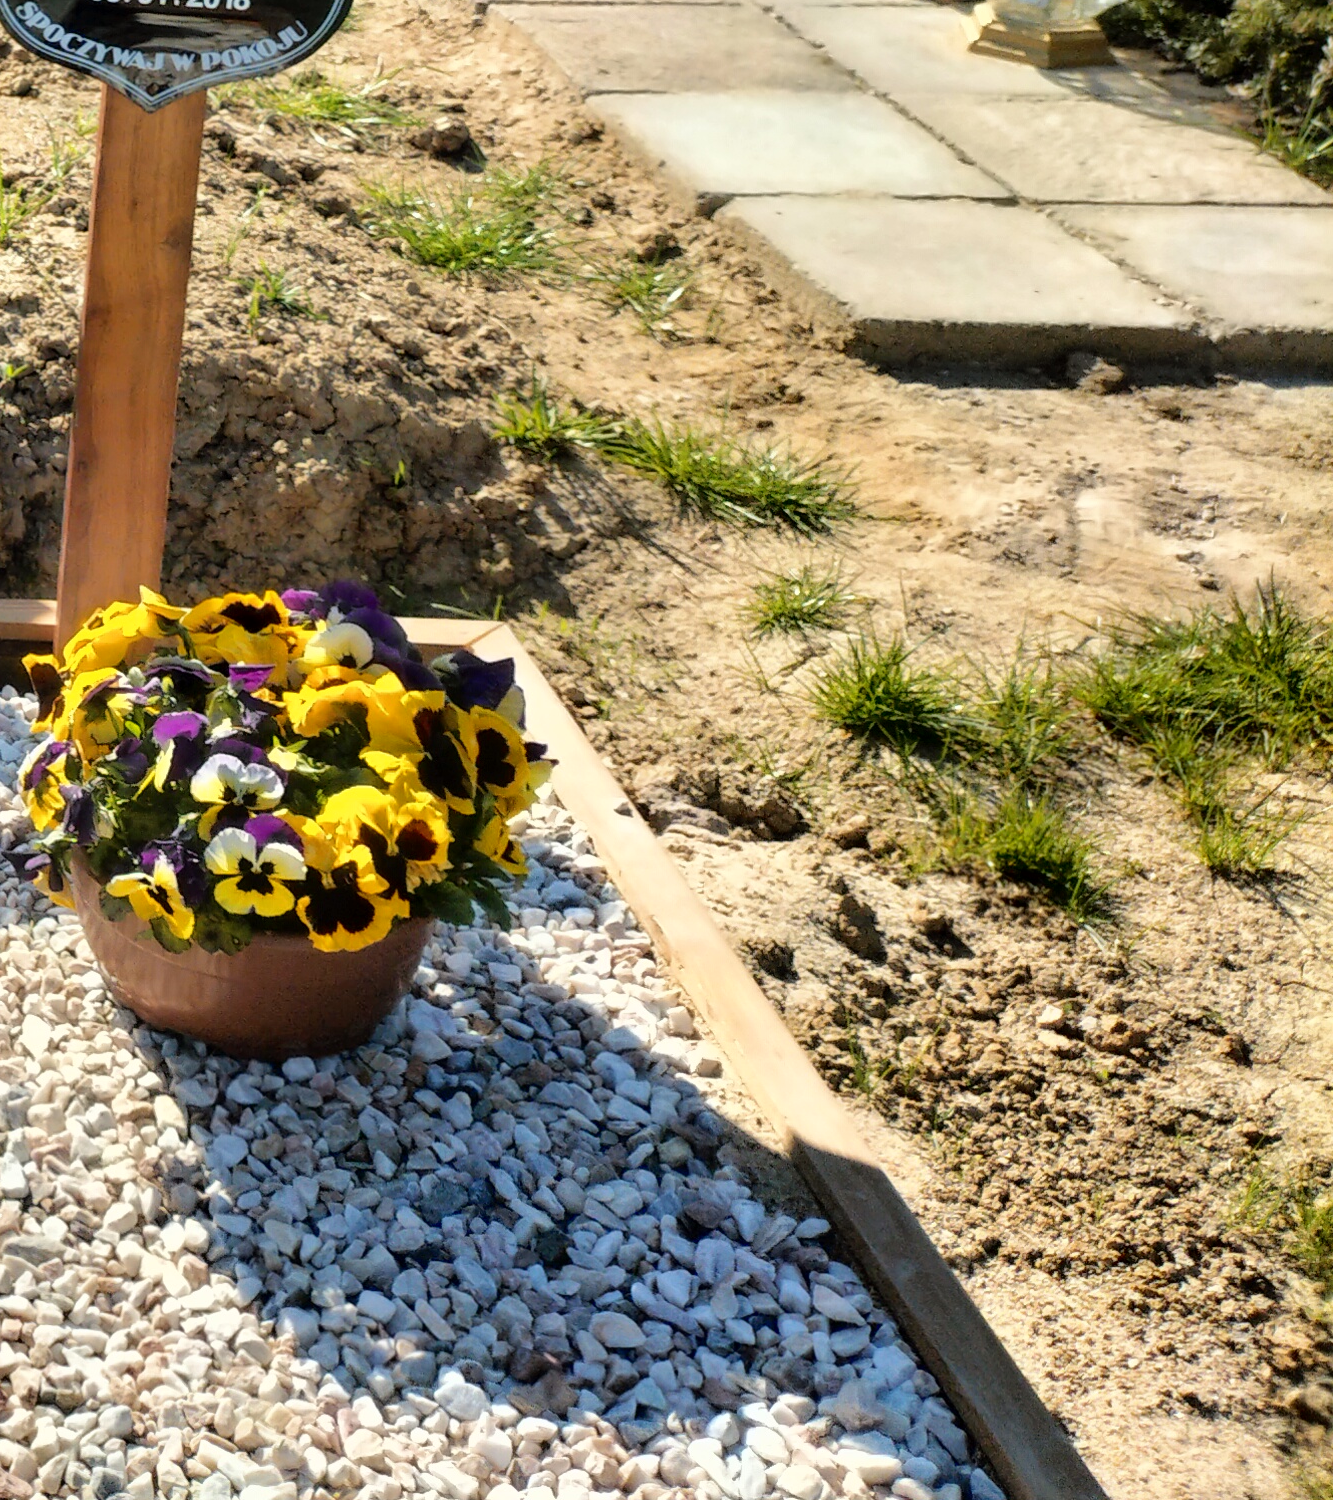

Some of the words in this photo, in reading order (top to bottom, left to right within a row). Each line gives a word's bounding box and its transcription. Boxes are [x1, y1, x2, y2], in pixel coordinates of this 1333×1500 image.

[15, 1, 165, 72] SPOCZYWAJ
[170, 53, 197, 72] W
[201, 19, 310, 72] POKOJU
